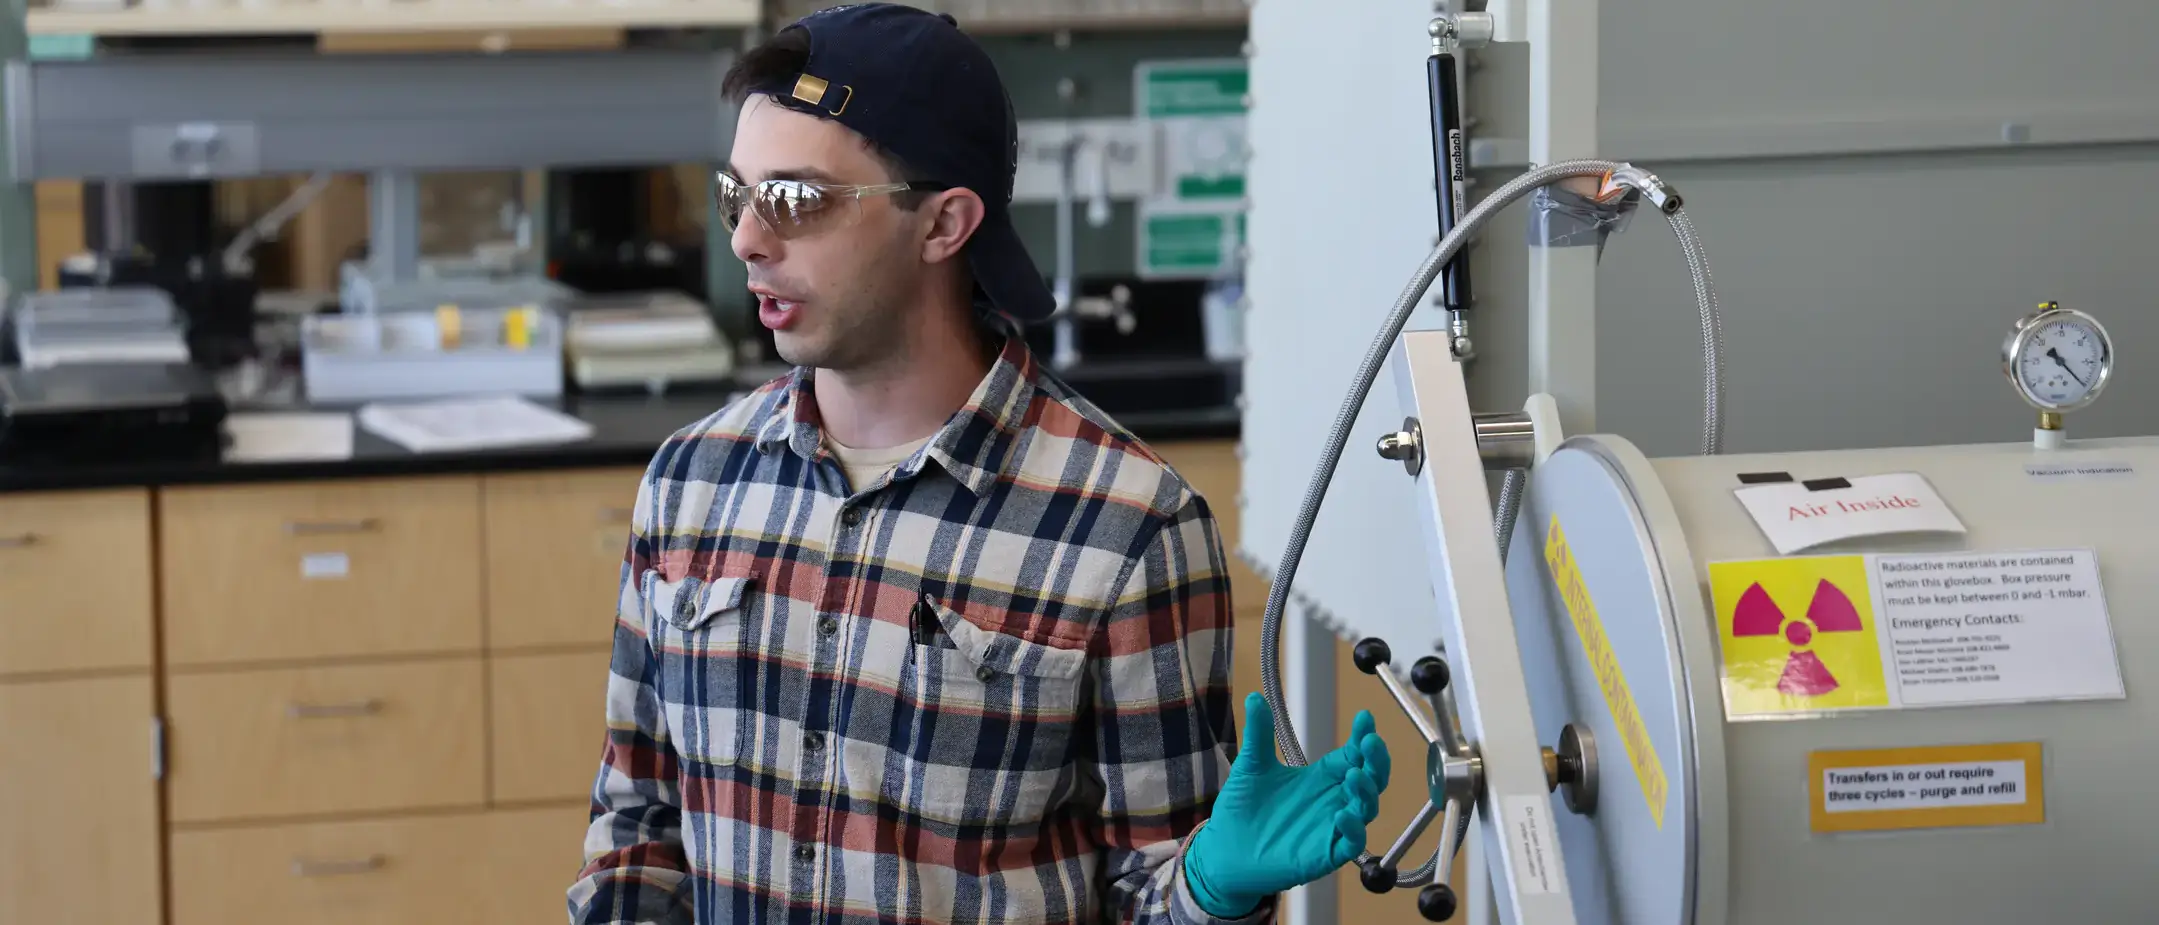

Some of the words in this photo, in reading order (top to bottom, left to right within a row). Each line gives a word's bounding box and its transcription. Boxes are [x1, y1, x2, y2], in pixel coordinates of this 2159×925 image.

[1451, 132, 1463, 182] Bansbach
[2077, 467, 2134, 475] Indication
[1788, 503, 1829, 522] Air
[1836, 495, 1922, 514] Inside
[1881, 561, 1944, 572] Radioactive
[1946, 558, 1998, 570] materials
[2000, 559, 2017, 567] are
[2020, 555, 2074, 566] contained
[1885, 577, 1919, 589] within
[1921, 576, 1942, 588] this
[2001, 573, 2022, 584] Box
[2024, 572, 2072, 585] pressure
[1888, 595, 1916, 606] must
[1918, 593, 1932, 604] be
[1934, 592, 1959, 607] kept
[1961, 591, 2008, 603] between
[2010, 591, 2019, 600] 0
[2021, 589, 2042, 600] and
[2044, 589, 2055, 599] -1
[2058, 587, 2091, 599] mbar.
[1892, 617, 1961, 630] Emergency
[1964, 613, 2024, 626] Contacts:
[1565, 569, 1604, 672] INTERNAL
[1600, 652, 1665, 823] CONTAMINATION
[1828, 771, 1889, 784] Transfers
[1892, 770, 1904, 781] in
[1907, 770, 1921, 781] or
[1924, 769, 1946, 780] out
[1949, 766, 1995, 780] require
[1828, 790, 1862, 801] three
[1864, 787, 1906, 802] cycles
[1920, 786, 1957, 799] purge
[1960, 783, 1985, 796] and
[1988, 781, 2016, 794] refill
